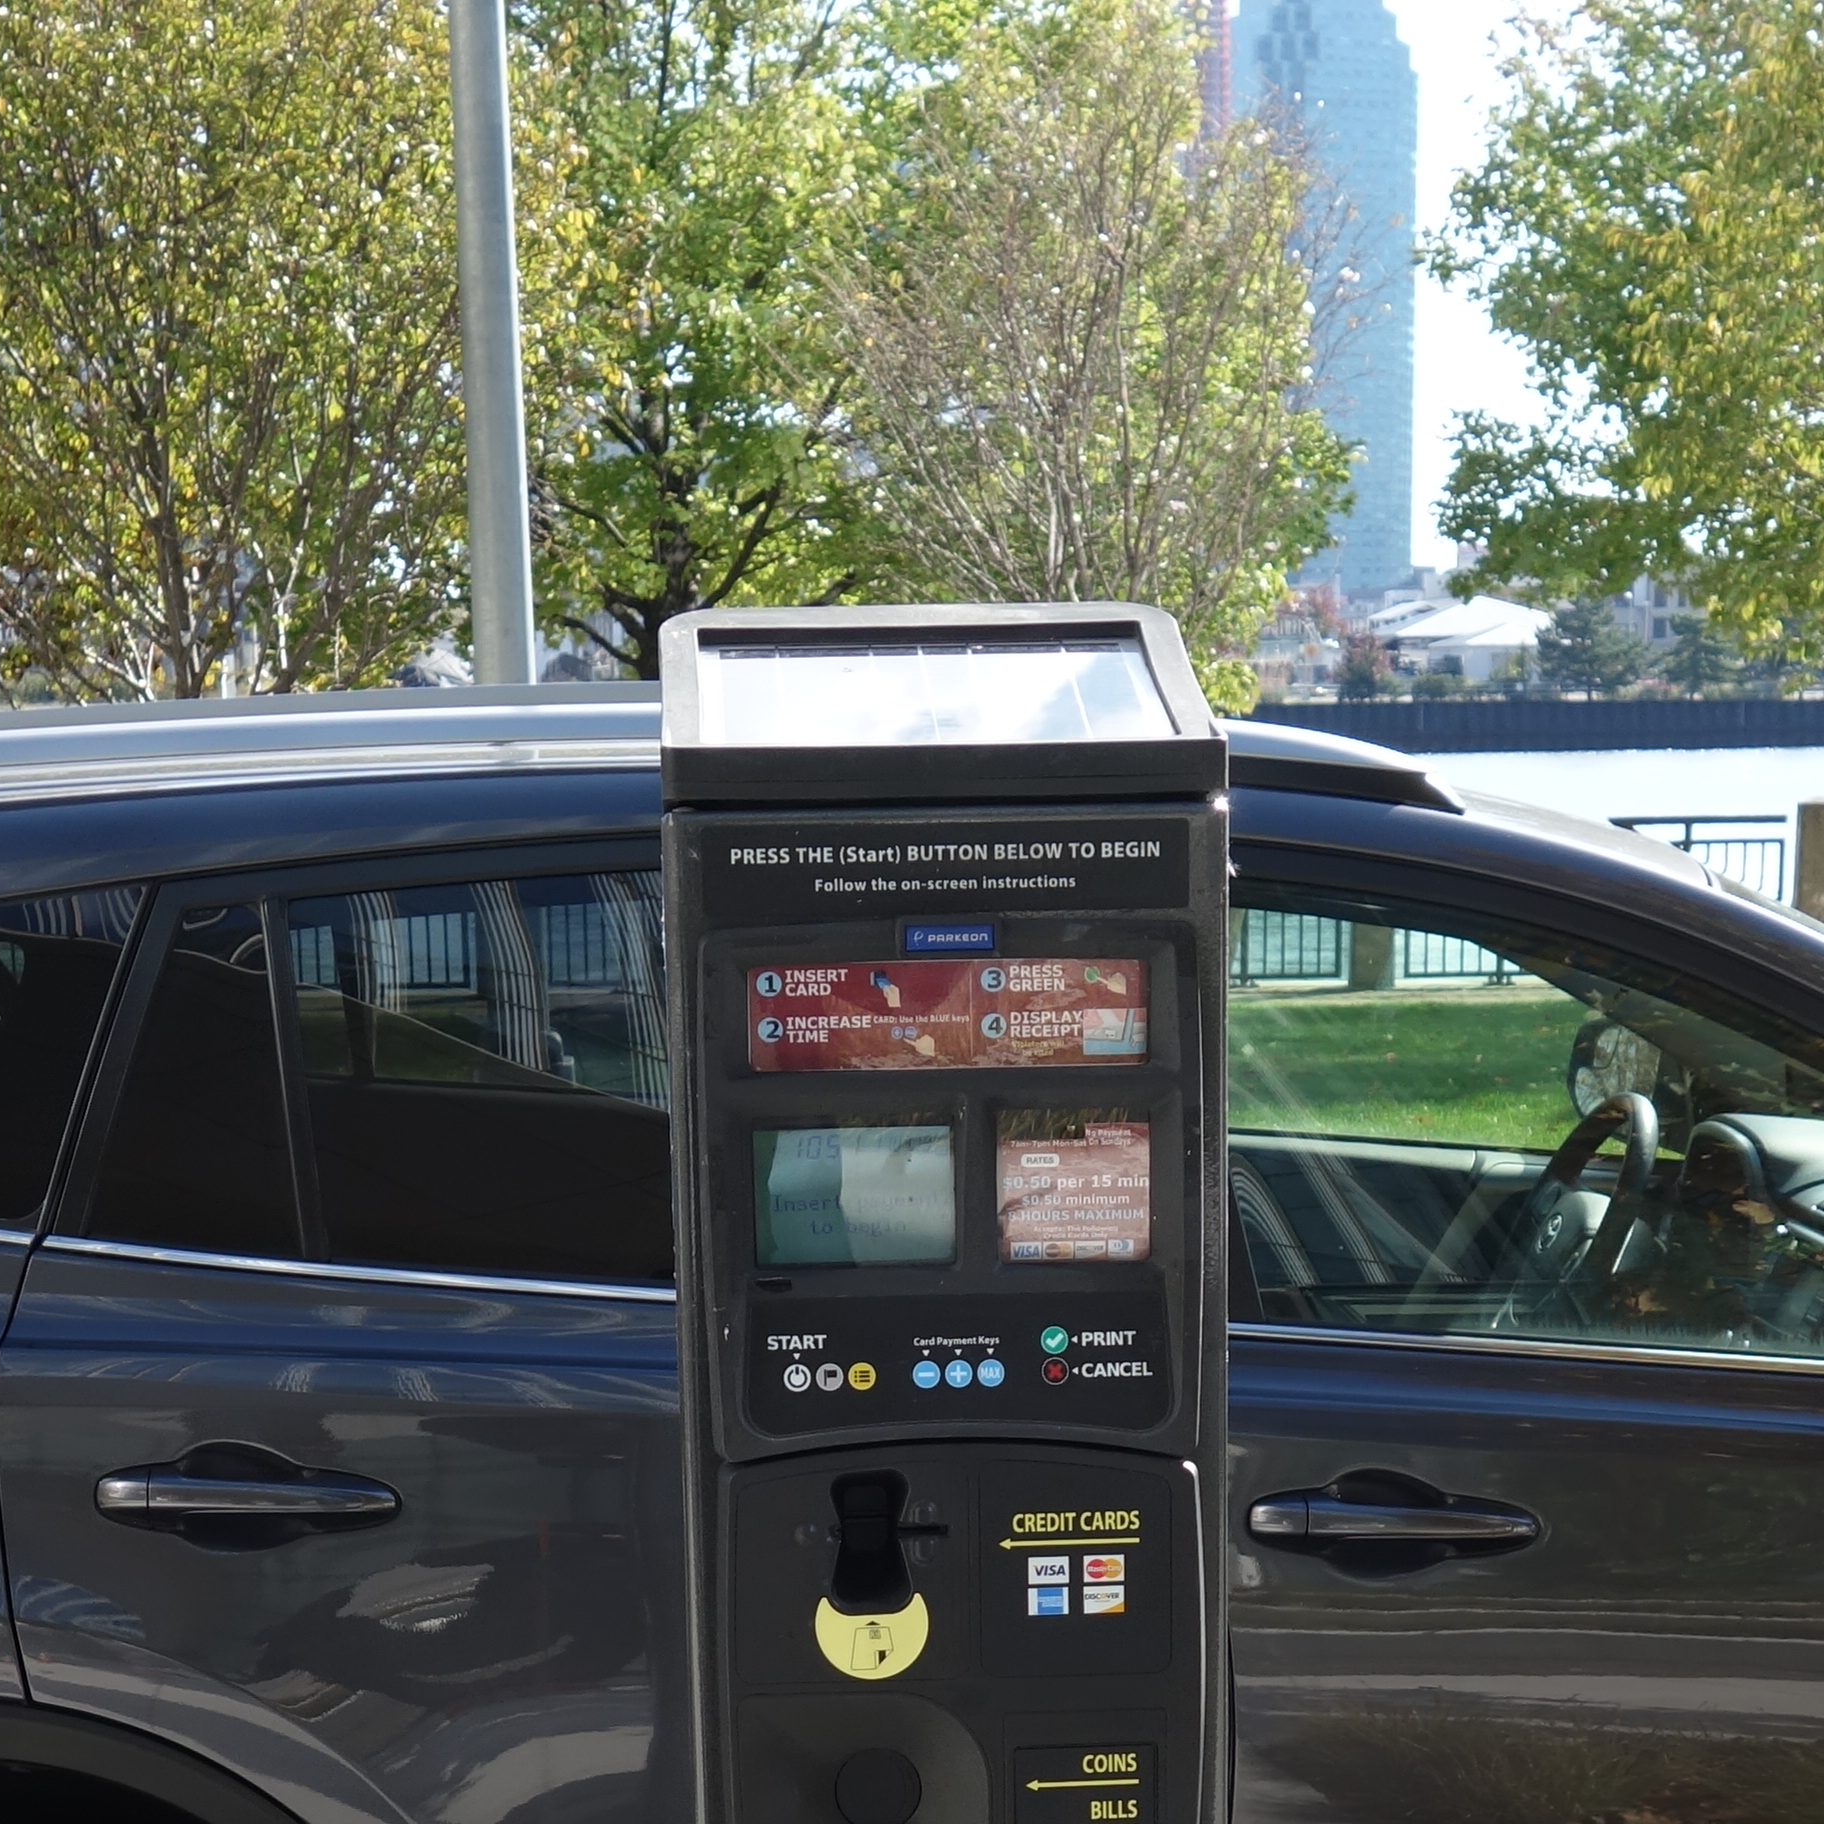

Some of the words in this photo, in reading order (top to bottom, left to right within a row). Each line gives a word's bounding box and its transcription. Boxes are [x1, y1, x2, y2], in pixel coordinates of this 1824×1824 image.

[730, 847, 790, 865] PRESS
[795, 847, 834, 863] THE
[839, 845, 901, 865] (Start)
[907, 844, 988, 862] BUTTON
[994, 842, 1062, 860] BELOW
[1068, 842, 1095, 858] TO
[1101, 841, 1161, 858] BEGIN
[814, 878, 866, 892] Follow
[871, 877, 896, 891] the
[901, 878, 977, 891] on-screen
[982, 874, 1076, 889] instructions
[927, 933, 988, 943] PARKEON
[784, 968, 848, 983] INSERT
[1009, 965, 1063, 978] PRESS
[784, 982, 832, 997] CARD
[1009, 978, 1065, 992] GREEN
[786, 1015, 871, 1030] INCREASE
[899, 1015, 914, 1023] Use
[915, 1014, 929, 1023] the
[929, 1014, 950, 1023] BLUE
[952, 1013, 970, 1024] keys
[1010, 1011, 1083, 1025] DISPLAY
[786, 1030, 829, 1043] TIME
[1010, 1024, 1081, 1038] RECEIPT
[1085, 1128, 1096, 1137] No
[1026, 1156, 1055, 1164] RATES
[1002, 1175, 1051, 1189] $0.50
[1057, 1177, 1085, 1190] per
[1091, 1174, 1112, 1187] 15
[773, 1194, 841, 1212] Insert
[1022, 1194, 1061, 1206] $0.50
[1065, 1194, 1130, 1205] minimum
[1008, 1210, 1017, 1222] 8
[1022, 1209, 1070, 1221] HOURS
[1074, 1209, 1145, 1220] MAXIMUM
[810, 1220, 833, 1235] to
[1012, 1245, 1041, 1258] VISA
[767, 1334, 827, 1351] START
[913, 1336, 936, 1346] Card
[936, 1336, 977, 1348] Payment
[978, 1336, 1000, 1346] Keys
[1081, 1331, 1137, 1347] PRINT
[980, 1367, 1001, 1379] MAX
[1081, 1361, 1153, 1378] CANCEL
[1012, 1511, 1077, 1533] CREDIT
[1080, 1510, 1140, 1531] CARDS
[1034, 1564, 1066, 1577] VISA
[1084, 1592, 1120, 1601] DISCOVER
[1082, 1752, 1138, 1774] COINS
[1090, 1799, 1138, 1820] BILLS
